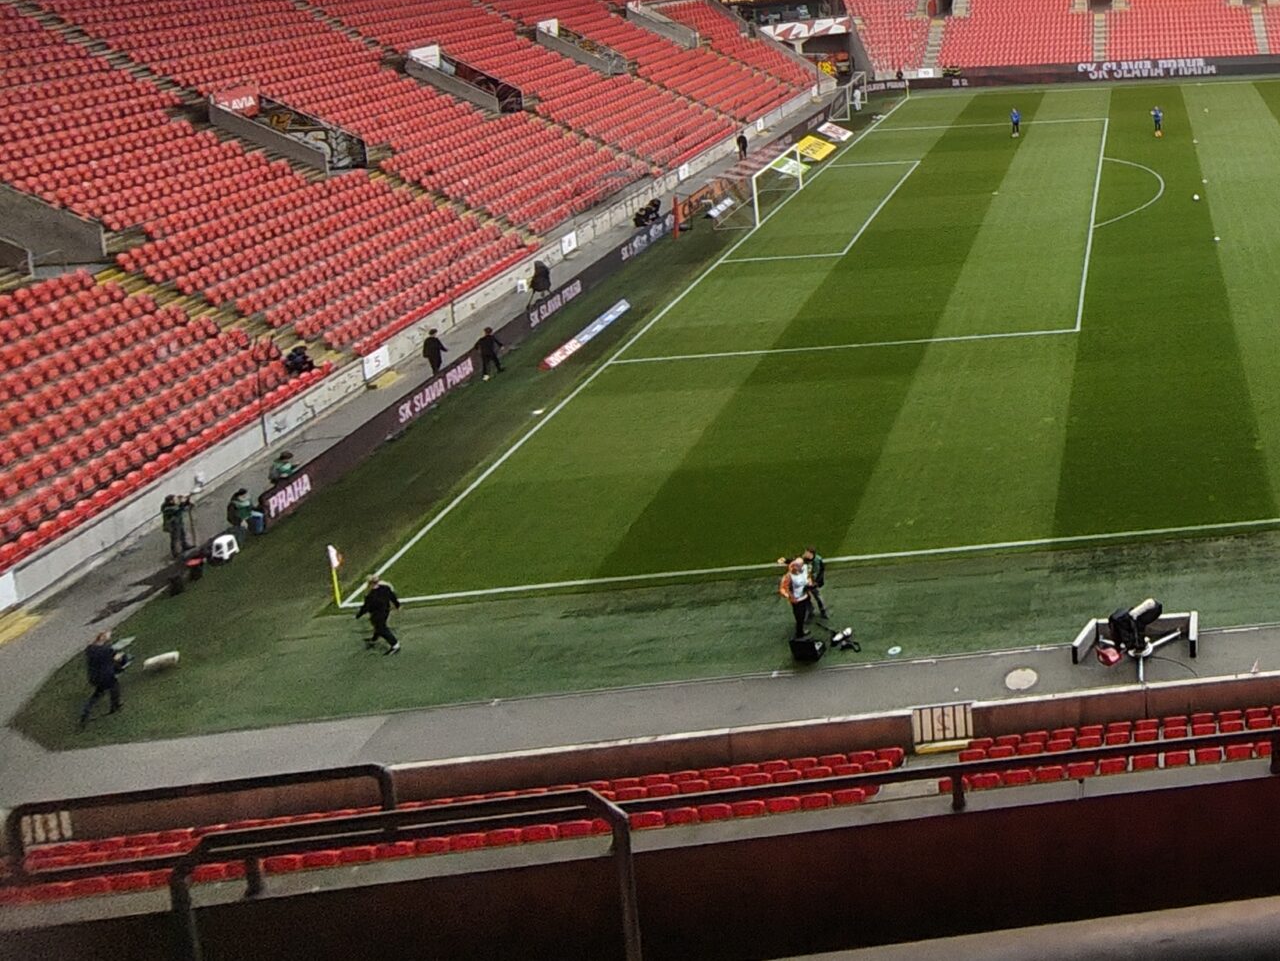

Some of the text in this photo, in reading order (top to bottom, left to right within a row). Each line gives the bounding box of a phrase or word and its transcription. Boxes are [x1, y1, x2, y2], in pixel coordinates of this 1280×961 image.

[398, 357, 474, 424] SK SLAVIA PRAHA
[268, 473, 312, 518] PRAHA
